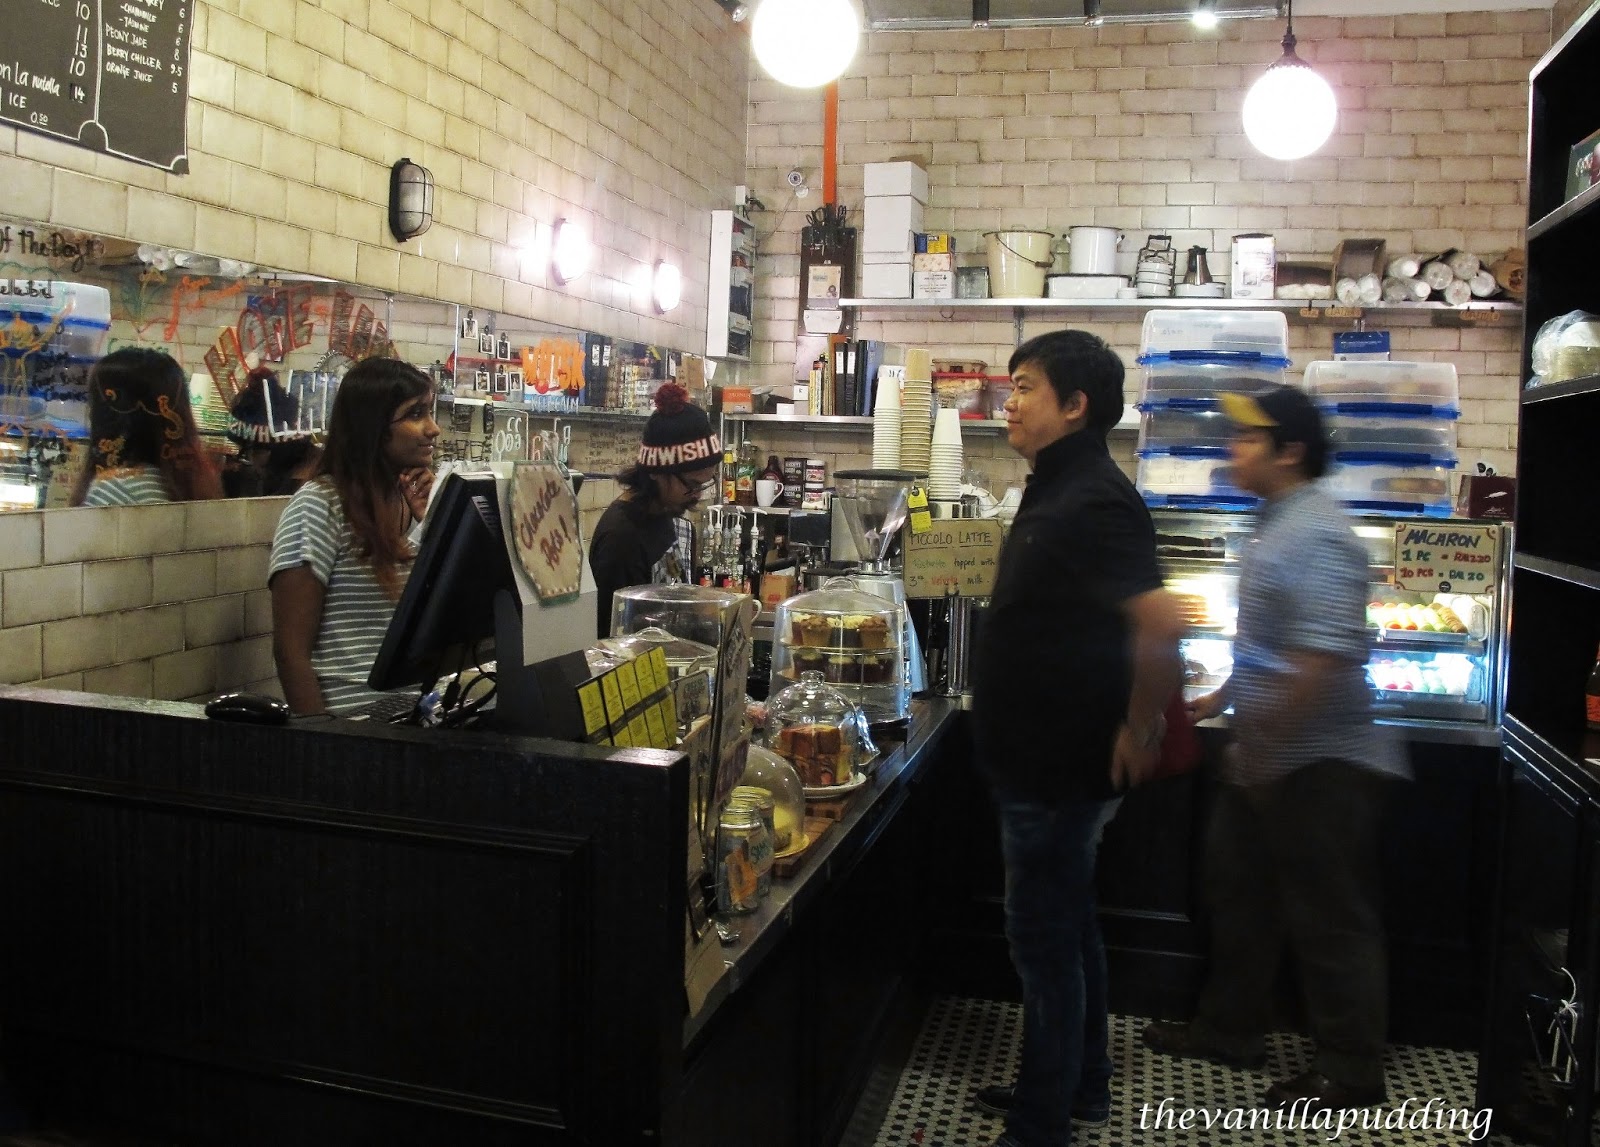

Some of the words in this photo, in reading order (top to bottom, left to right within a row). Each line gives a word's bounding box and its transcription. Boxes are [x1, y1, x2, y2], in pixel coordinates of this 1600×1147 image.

[76, 1, 91, 21] 10
[179, 8, 186, 18] 6
[76, 24, 88, 44] 11
[105, 23, 129, 43] PEONY
[75, 42, 88, 58] 13
[106, 43, 129, 61] BERRY
[131, 53, 162, 70] CHILLER
[69, 58, 86, 77] 10
[74, 86, 86, 100] 14
[171, 82, 179, 94] 5
[9, 92, 27, 109] ICE
[959, 531, 993, 544] LATTE
[1403, 529, 1481, 548] MACARON
[1401, 549, 1412, 561] 1
[1416, 550, 1431, 561] PC
[1400, 567, 1414, 578] 10
[1417, 568, 1434, 578] PCS
